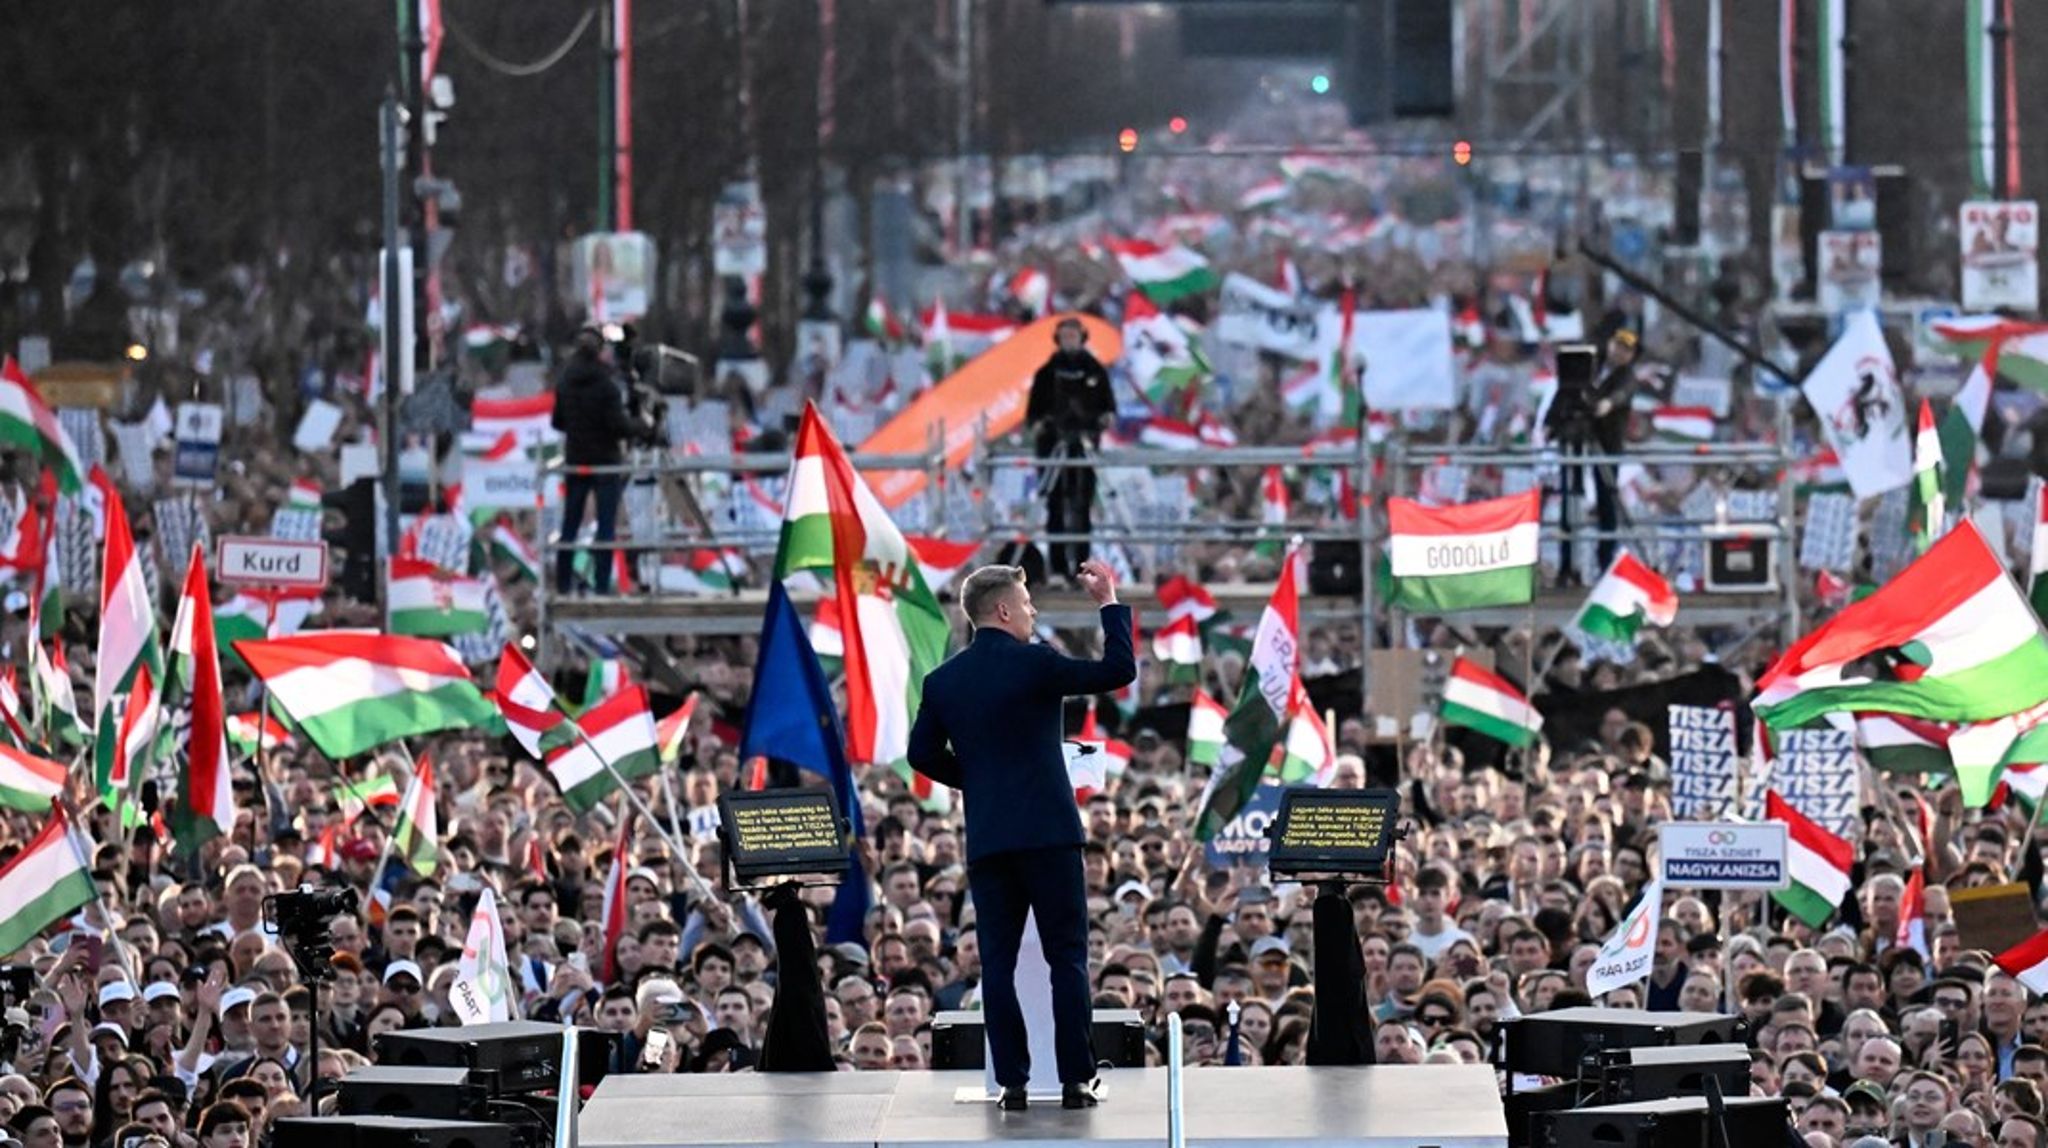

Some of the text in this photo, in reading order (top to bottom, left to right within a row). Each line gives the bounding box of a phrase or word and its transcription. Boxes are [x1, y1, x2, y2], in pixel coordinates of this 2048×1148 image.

[243, 551, 301, 574] Kurd
[1426, 536, 1509, 569] GÖDÖLLŐ
[1668, 704, 1735, 728] TISZA
[1668, 728, 1736, 751] TISZA
[1670, 750, 1737, 774] TISZA
[1671, 774, 1738, 797] TISZA
[1685, 848, 1762, 857] TISZA SZIGET
[1668, 861, 1778, 878] NAGYKANIZSA
